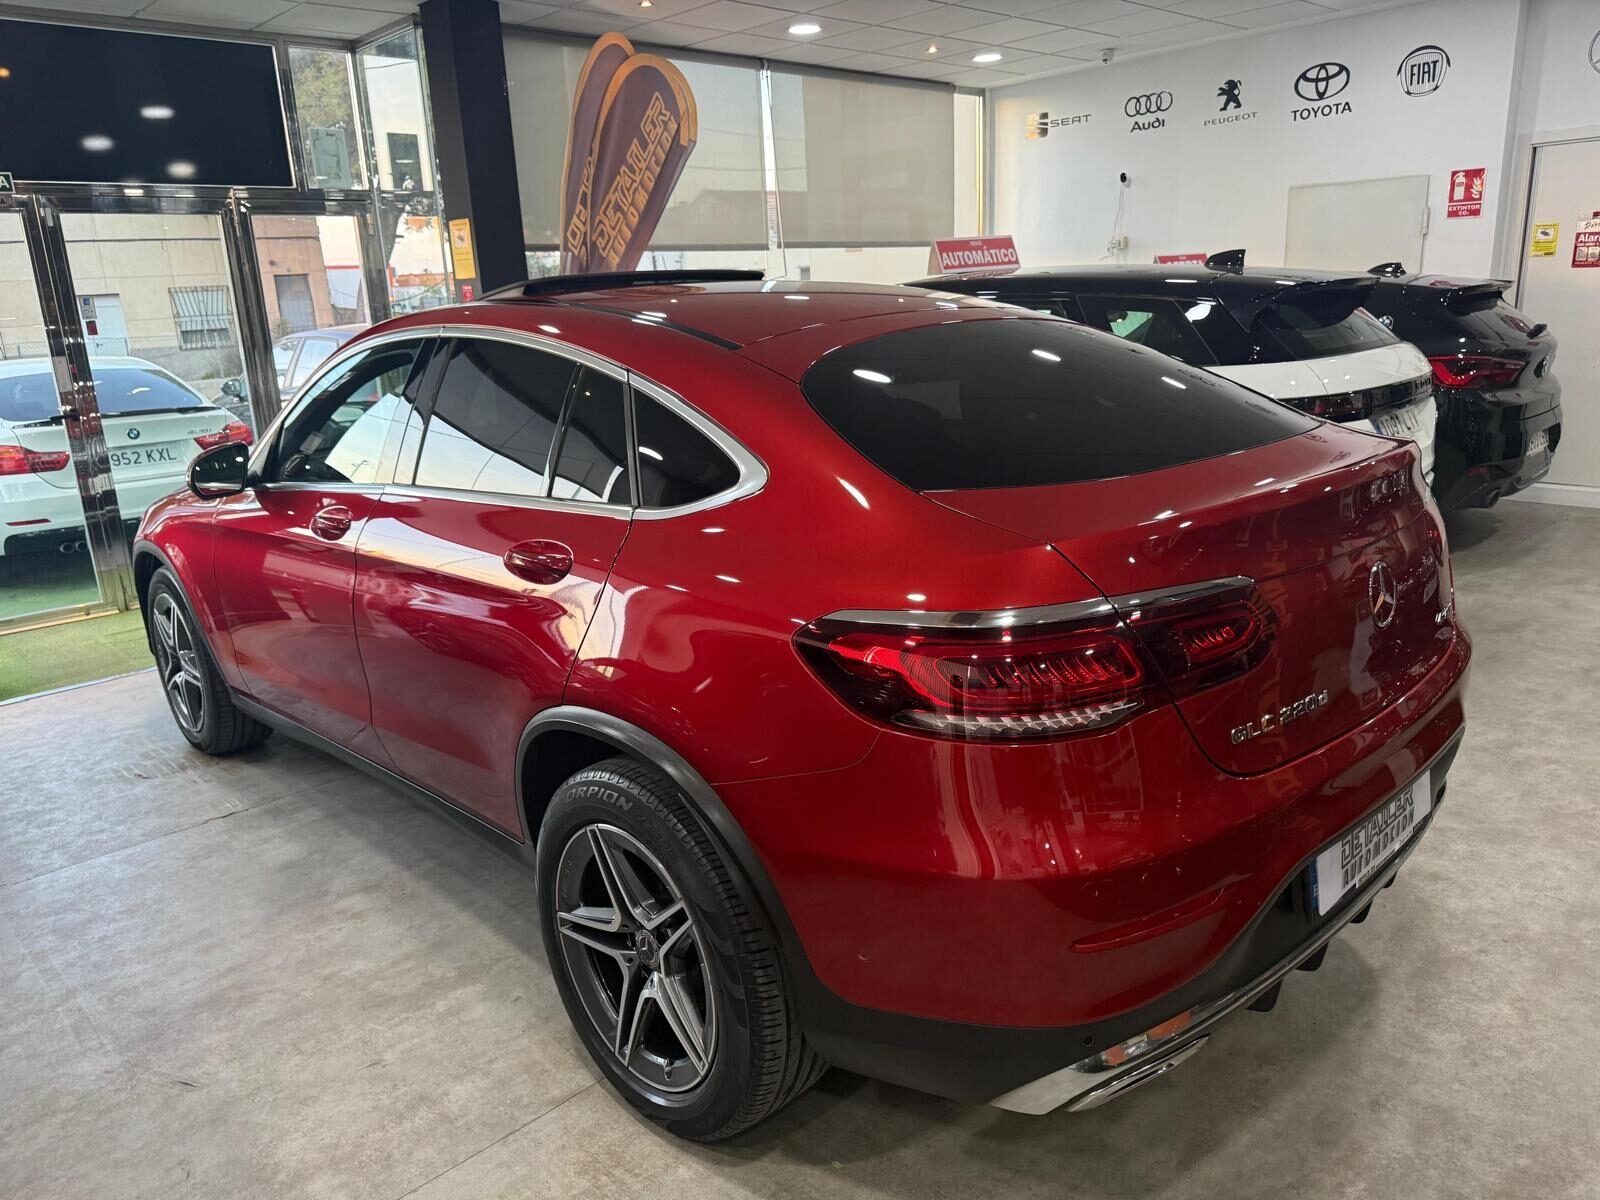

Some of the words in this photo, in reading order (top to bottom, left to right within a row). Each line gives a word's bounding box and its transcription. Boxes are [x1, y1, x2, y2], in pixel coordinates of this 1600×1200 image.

[1410, 60, 1439, 86] FIAT
[1050, 114, 1092, 128] SEAT
[1203, 111, 1258, 126] PEUGEOT
[1291, 101, 1352, 122] TOYOTA
[1130, 117, 1166, 132] Audi
[592, 91, 670, 257] DETAILER
[942, 246, 1017, 266] AUTOMÁTICO
[145, 447, 177, 463] KXL
[1231, 714, 1275, 744] GLC
[1280, 690, 1328, 725] 220d
[1341, 786, 1414, 869] DETAILER
